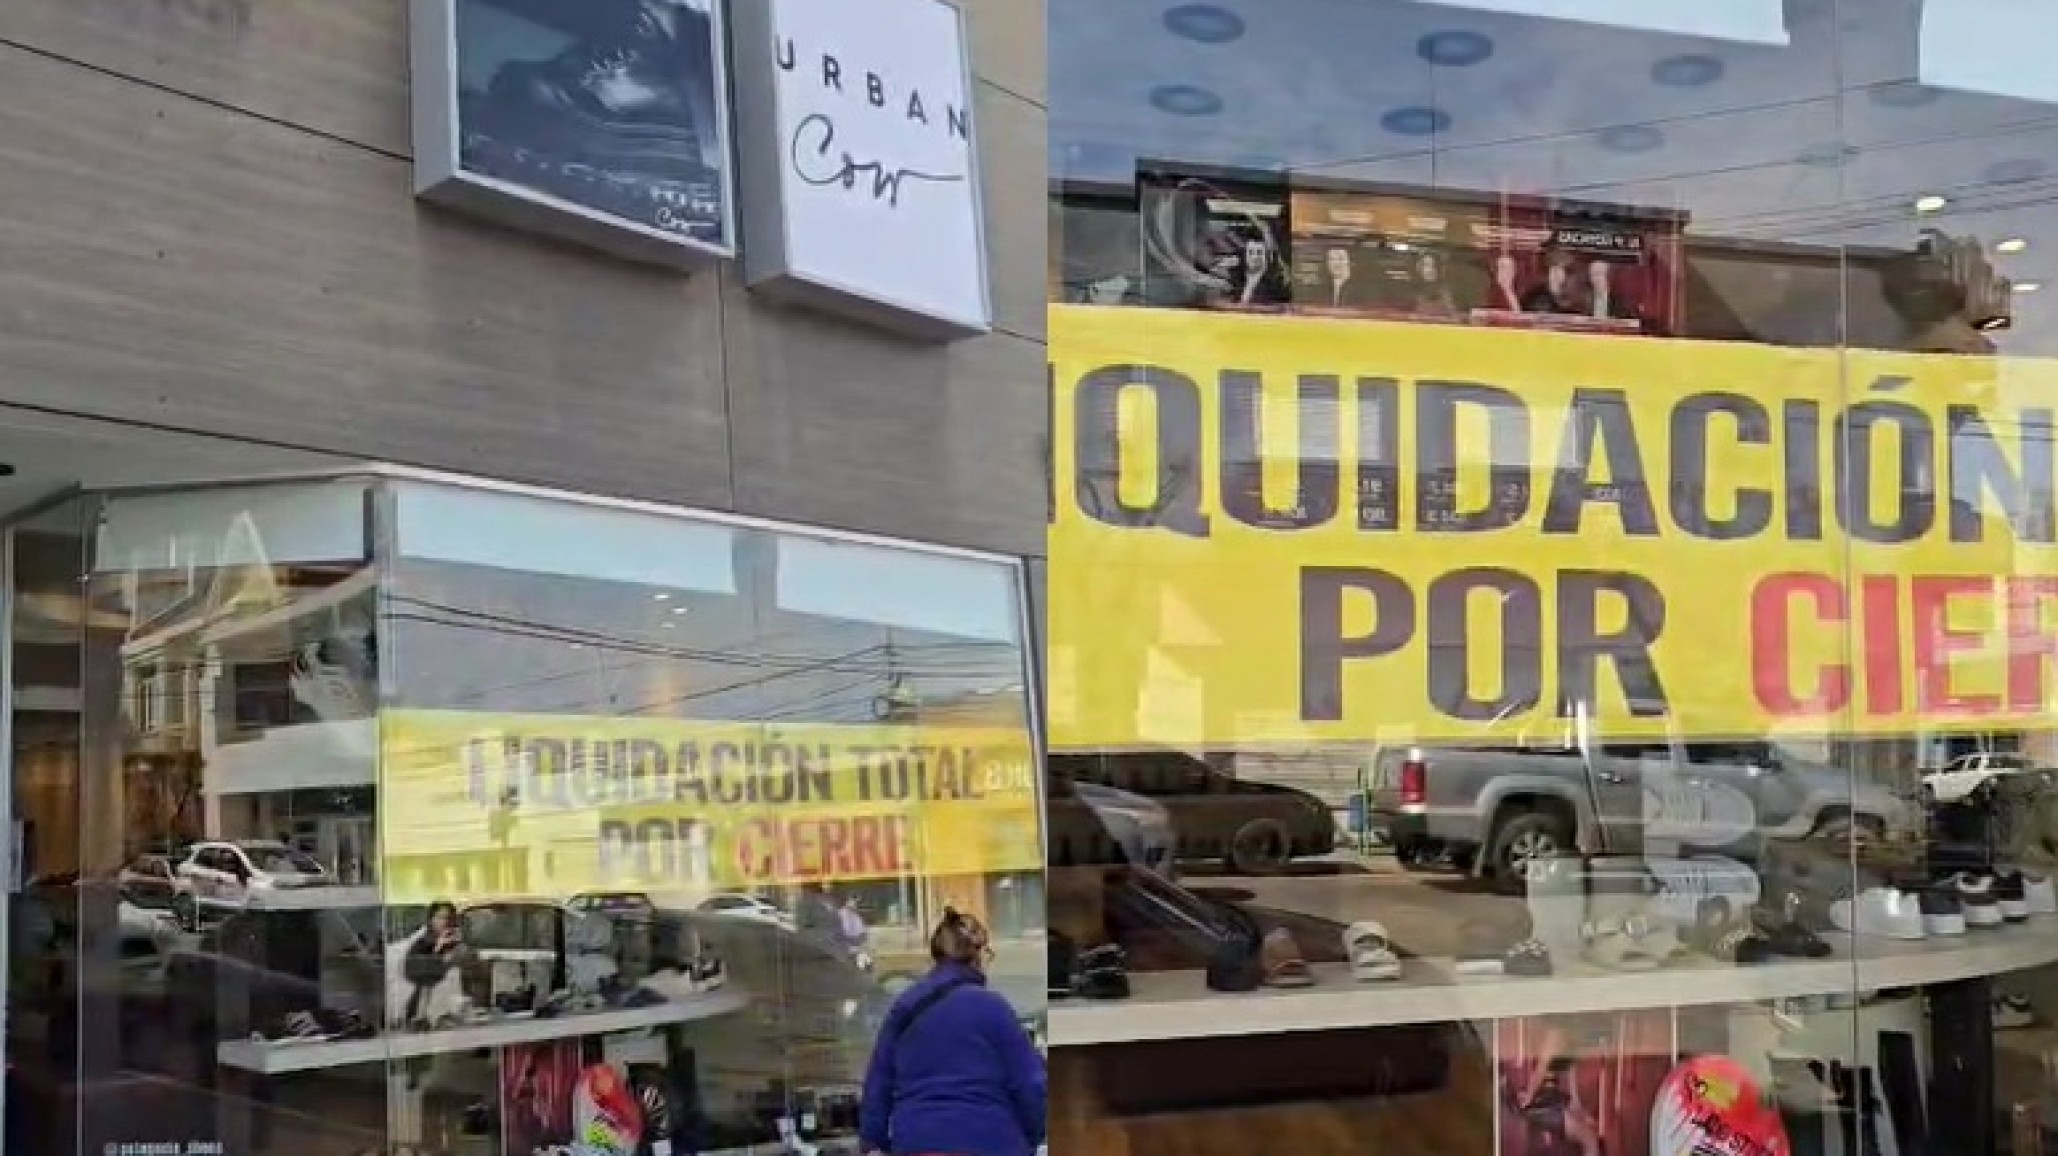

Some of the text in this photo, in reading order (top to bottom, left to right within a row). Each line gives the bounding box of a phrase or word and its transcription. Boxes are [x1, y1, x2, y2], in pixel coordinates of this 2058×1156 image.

[776, 35, 965, 147] URBAN
[1048, 362, 2056, 544] QUIDACIÓN
[1299, 565, 1672, 722] POR
[847, 746, 985, 800] TOTAL
[600, 815, 913, 883] POR CIERRE
